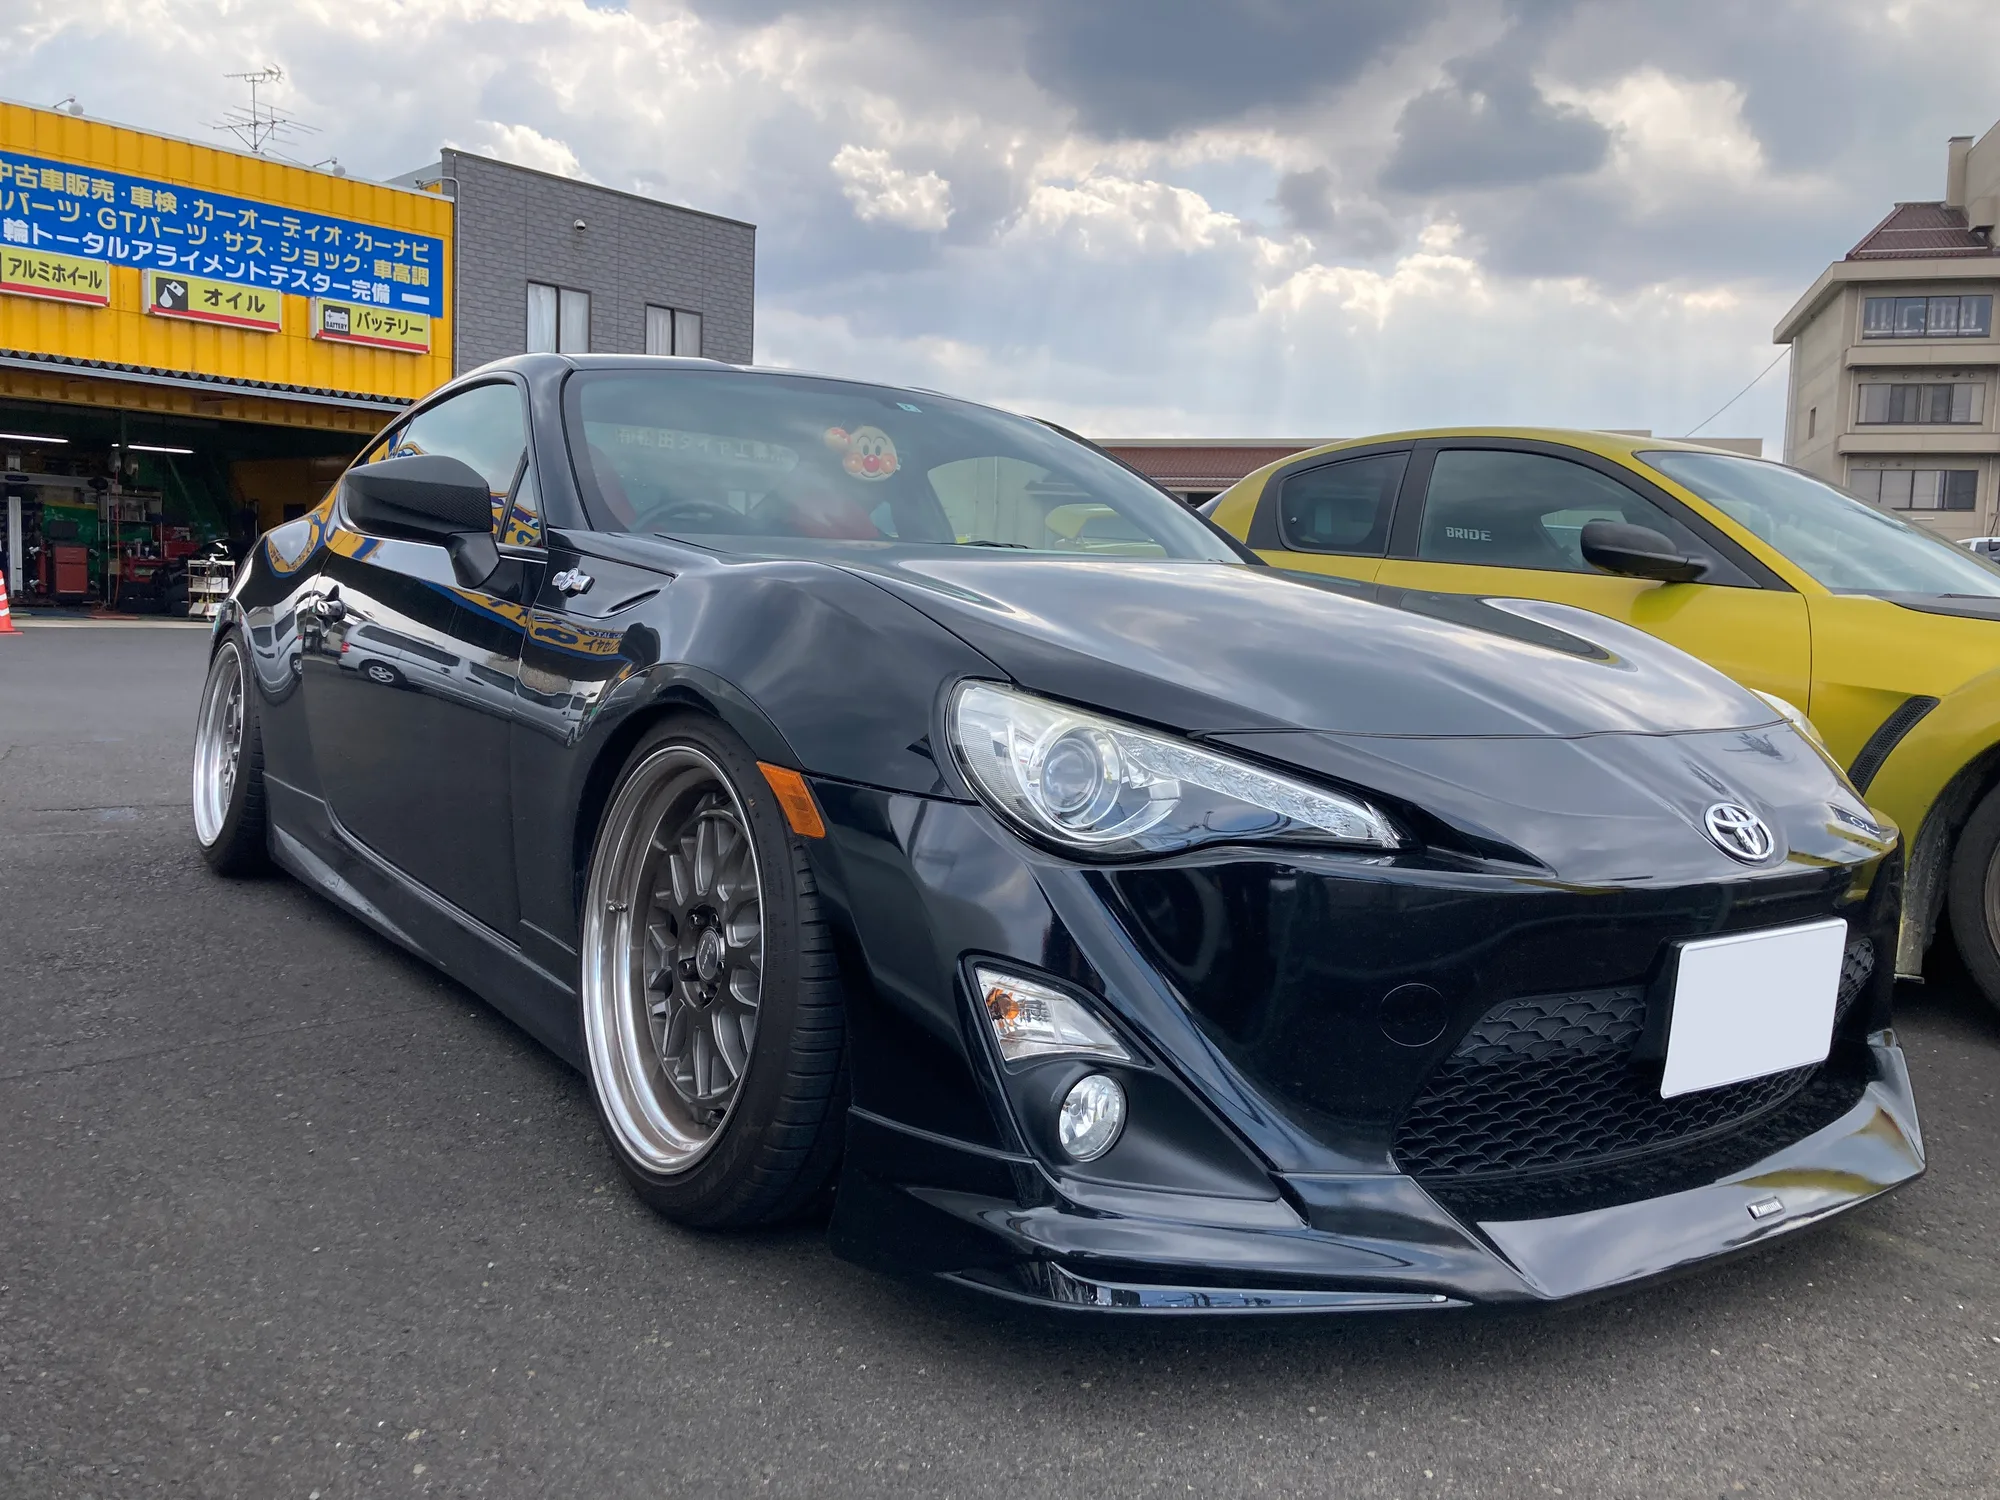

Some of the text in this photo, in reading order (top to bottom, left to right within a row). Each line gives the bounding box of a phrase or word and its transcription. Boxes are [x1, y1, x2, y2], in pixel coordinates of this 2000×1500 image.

[8, 257, 103, 289] アルミホイール
[203, 288, 266, 313] オイル
[326, 320, 348, 331] BATTERY
[356, 311, 423, 336] バッテリー
[1445, 526, 1492, 542] BRIDE
